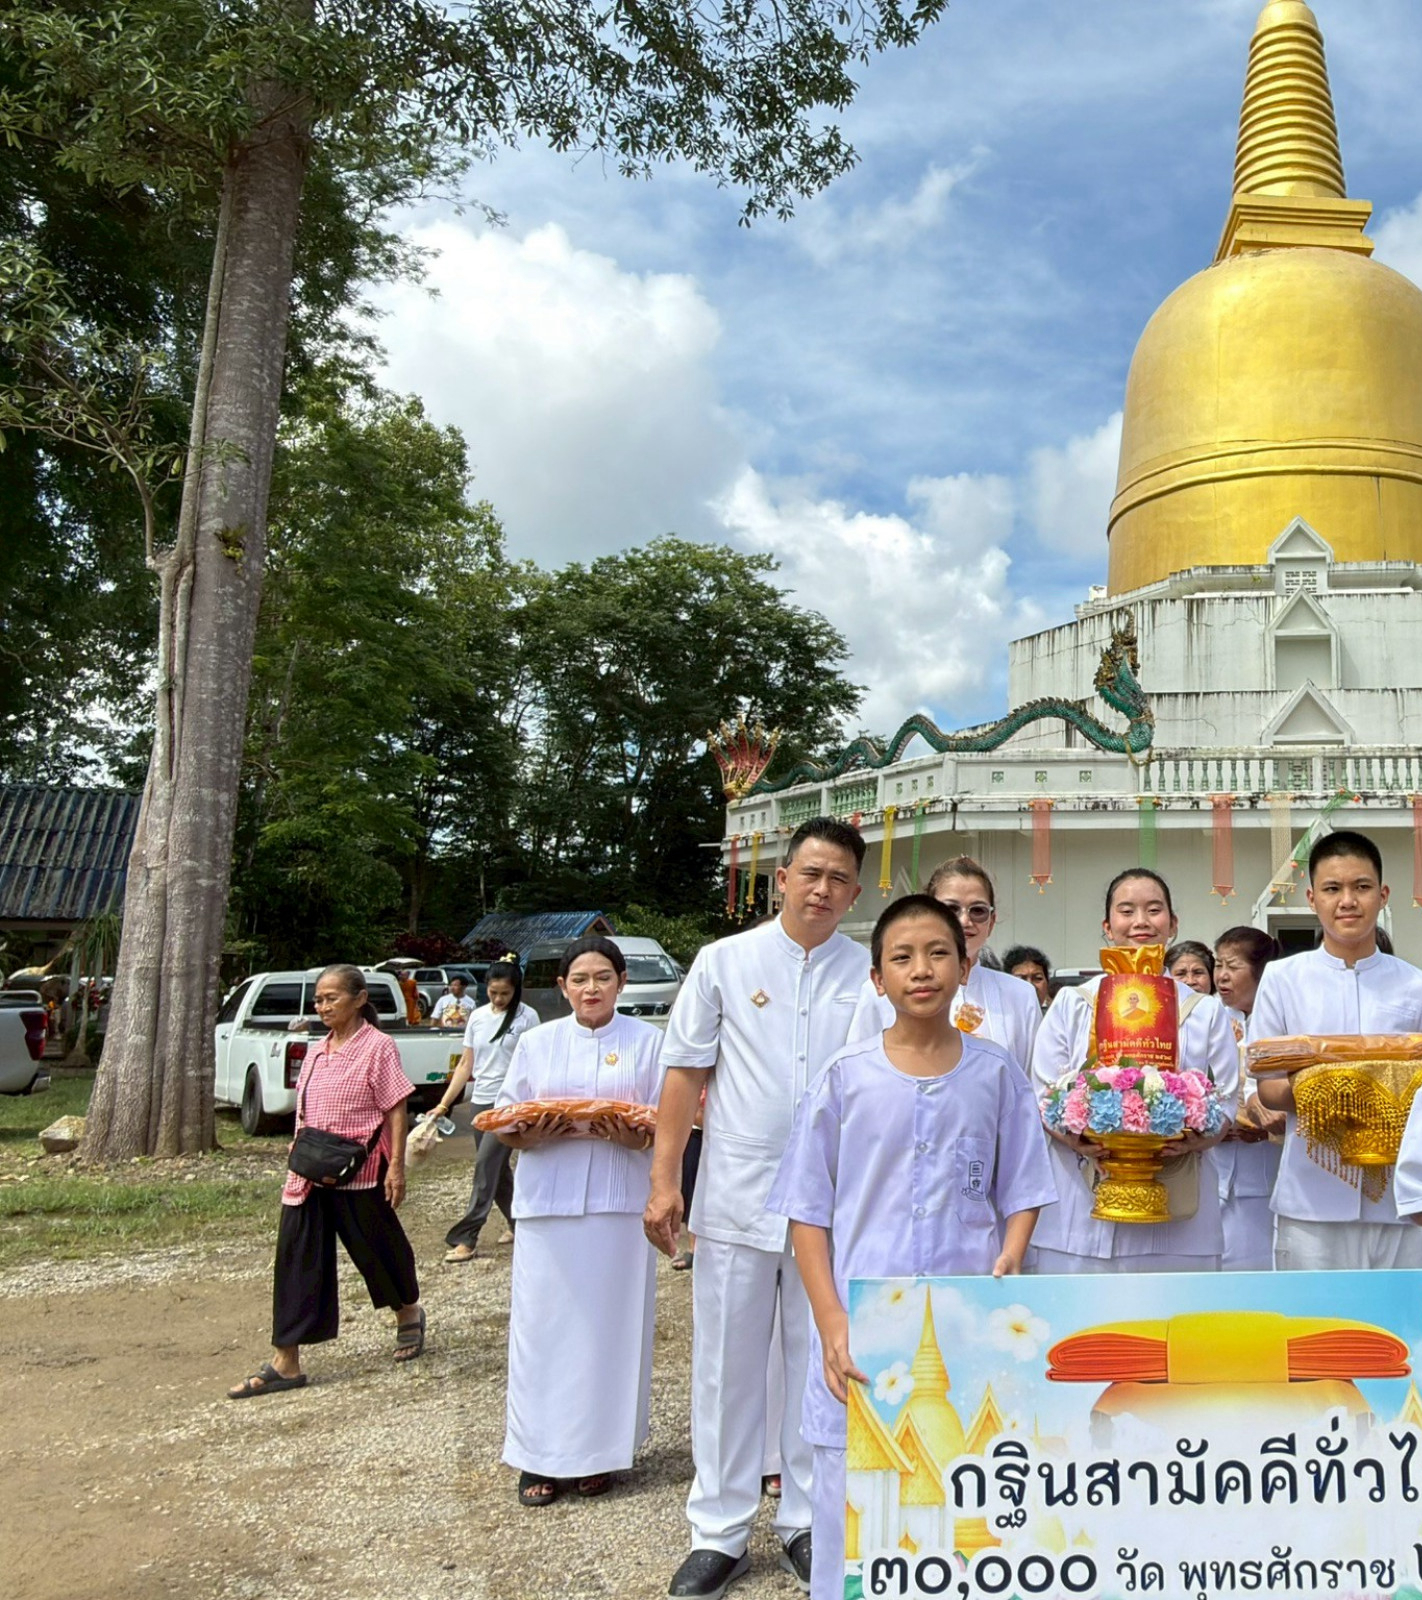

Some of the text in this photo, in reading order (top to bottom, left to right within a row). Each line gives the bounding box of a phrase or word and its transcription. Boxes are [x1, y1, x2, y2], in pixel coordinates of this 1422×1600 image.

[870, 1554, 1098, 1600] ๓๐,๐๐๐
[1116, 1547, 1165, 1592] วัด
[1178, 1545, 1396, 1600] พุทธศักราช
